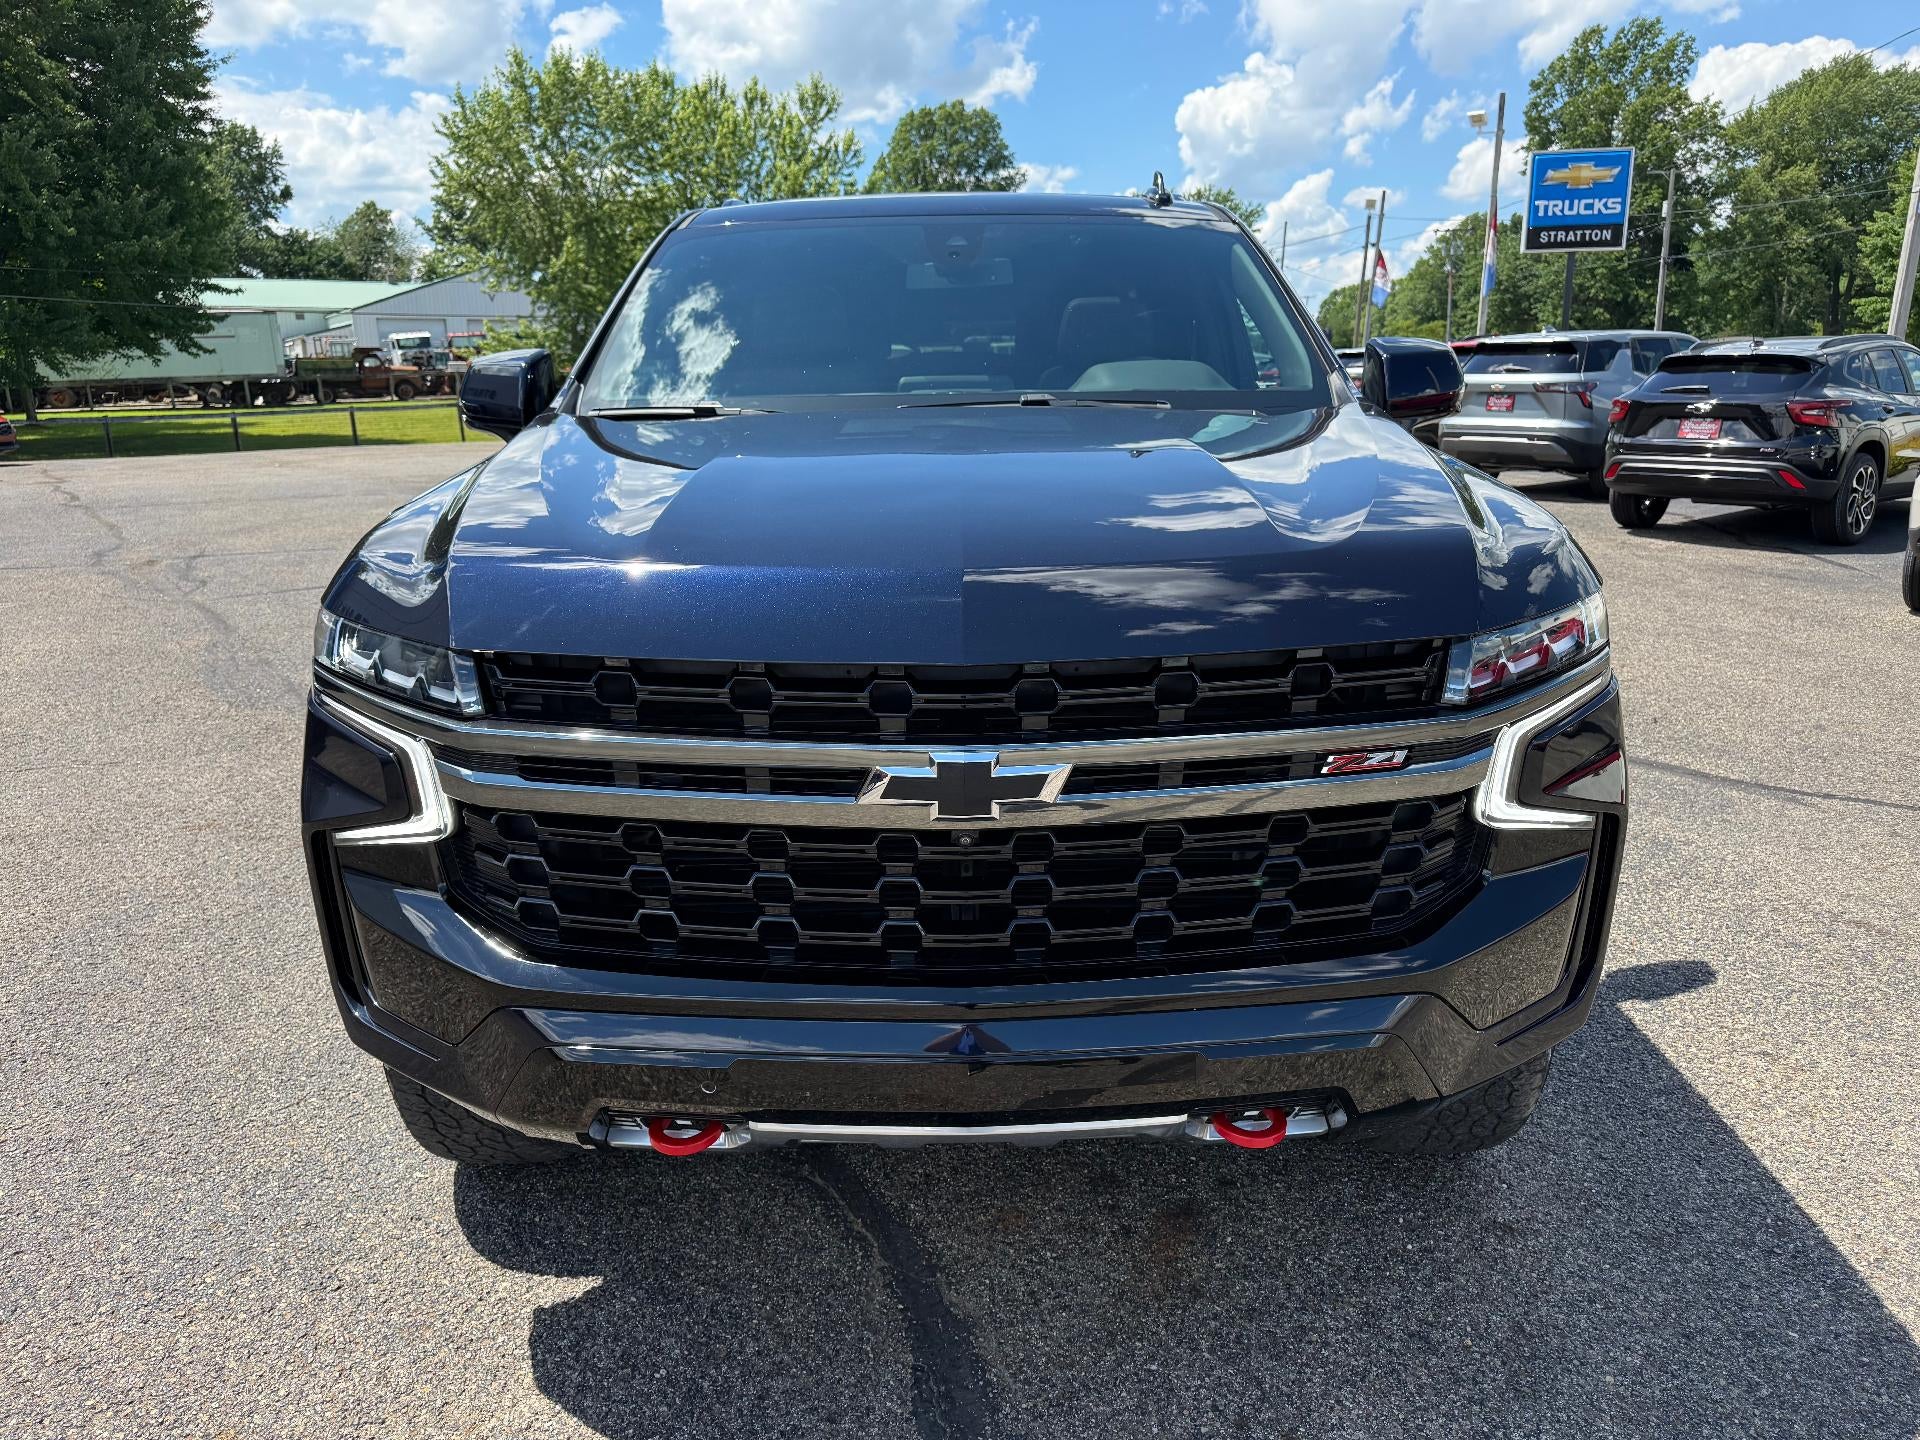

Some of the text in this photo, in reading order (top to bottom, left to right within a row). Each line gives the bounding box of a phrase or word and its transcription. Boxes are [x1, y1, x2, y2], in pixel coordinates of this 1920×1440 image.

[1534, 197, 1622, 217] TRUCKS
[1539, 229, 1612, 243] STRATTON
[1320, 749, 1409, 774] Z71
